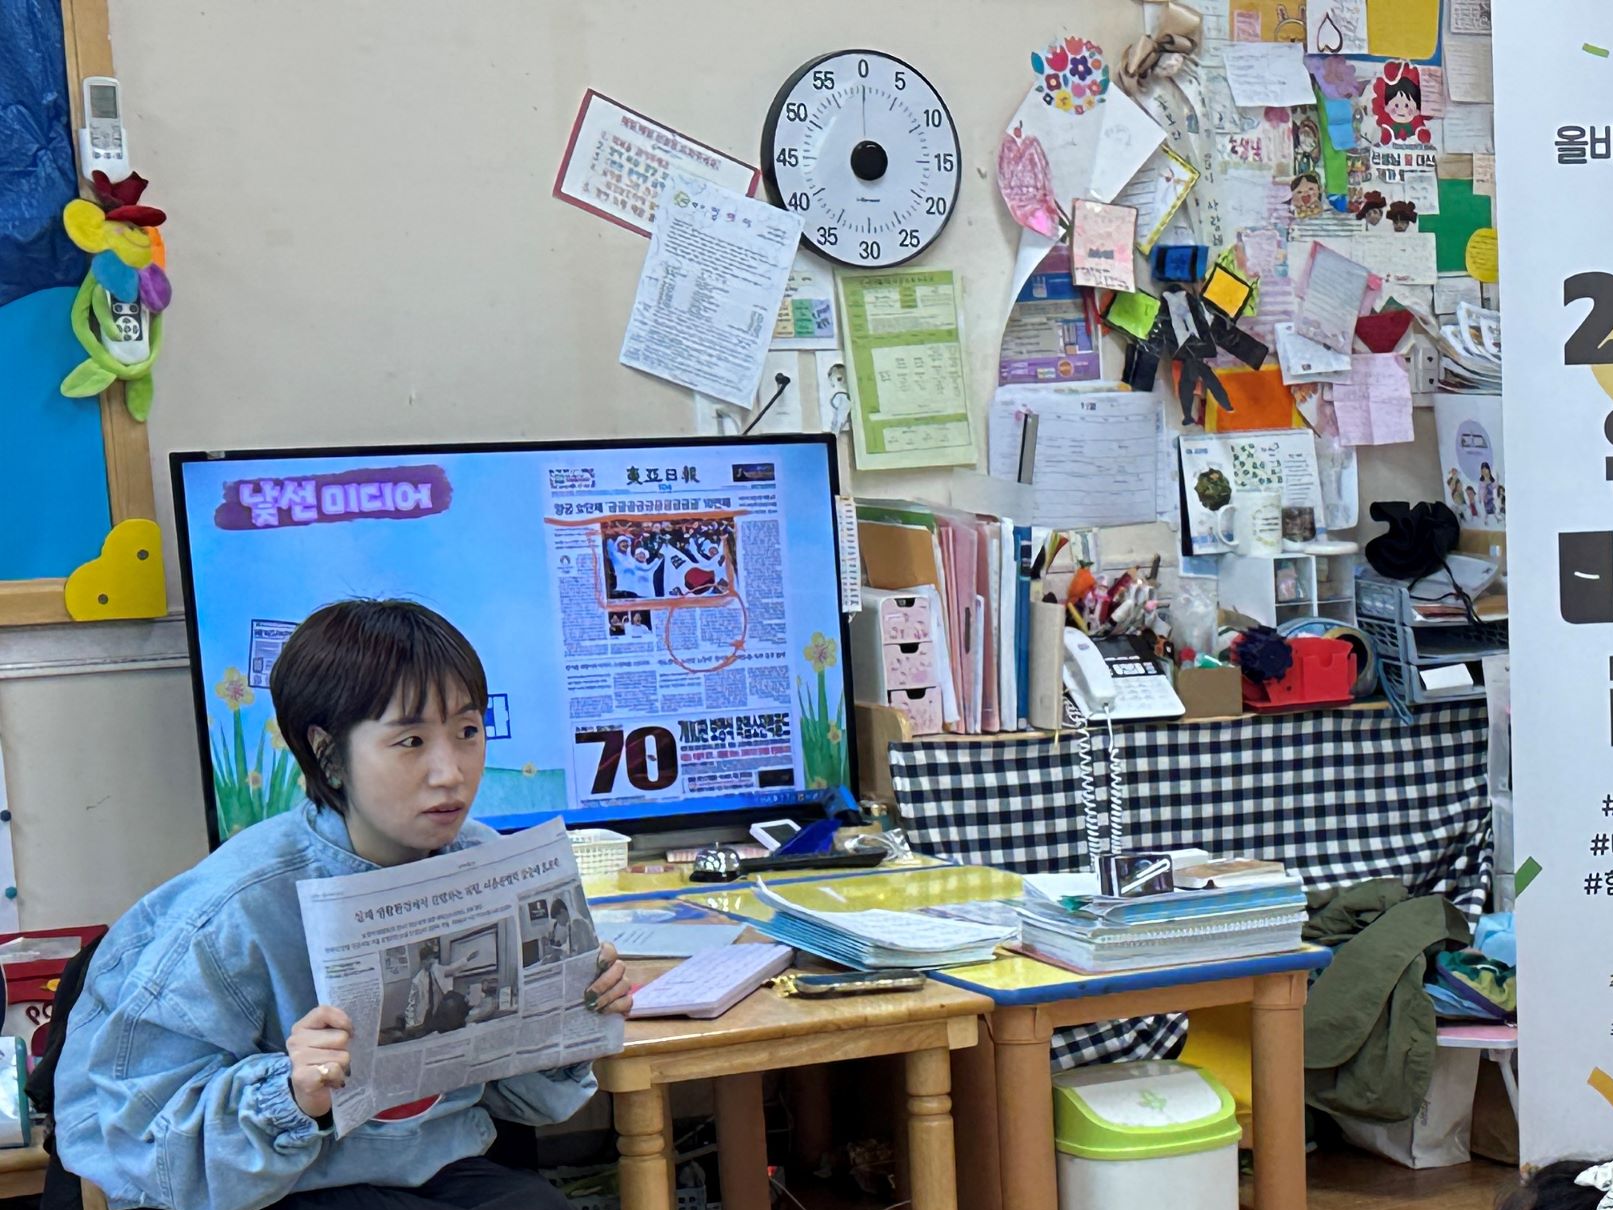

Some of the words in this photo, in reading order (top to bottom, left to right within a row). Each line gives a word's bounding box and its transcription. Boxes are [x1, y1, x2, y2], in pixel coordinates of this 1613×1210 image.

[857, 59, 869, 78] 0
[813, 70, 835, 90] 55
[895, 72, 906, 90] 5
[786, 103, 807, 122] 50
[924, 109, 942, 128] 10
[776, 147, 798, 166] 45
[935, 152, 953, 171] 15
[788, 192, 810, 212] 40
[926, 197, 947, 215] 20
[817, 226, 838, 246] 35
[899, 229, 920, 248] 25
[859, 241, 881, 260] 30
[239, 480, 318, 527] 낯선
[321, 481, 432, 515] 미디어
[575, 725, 679, 795] 70
